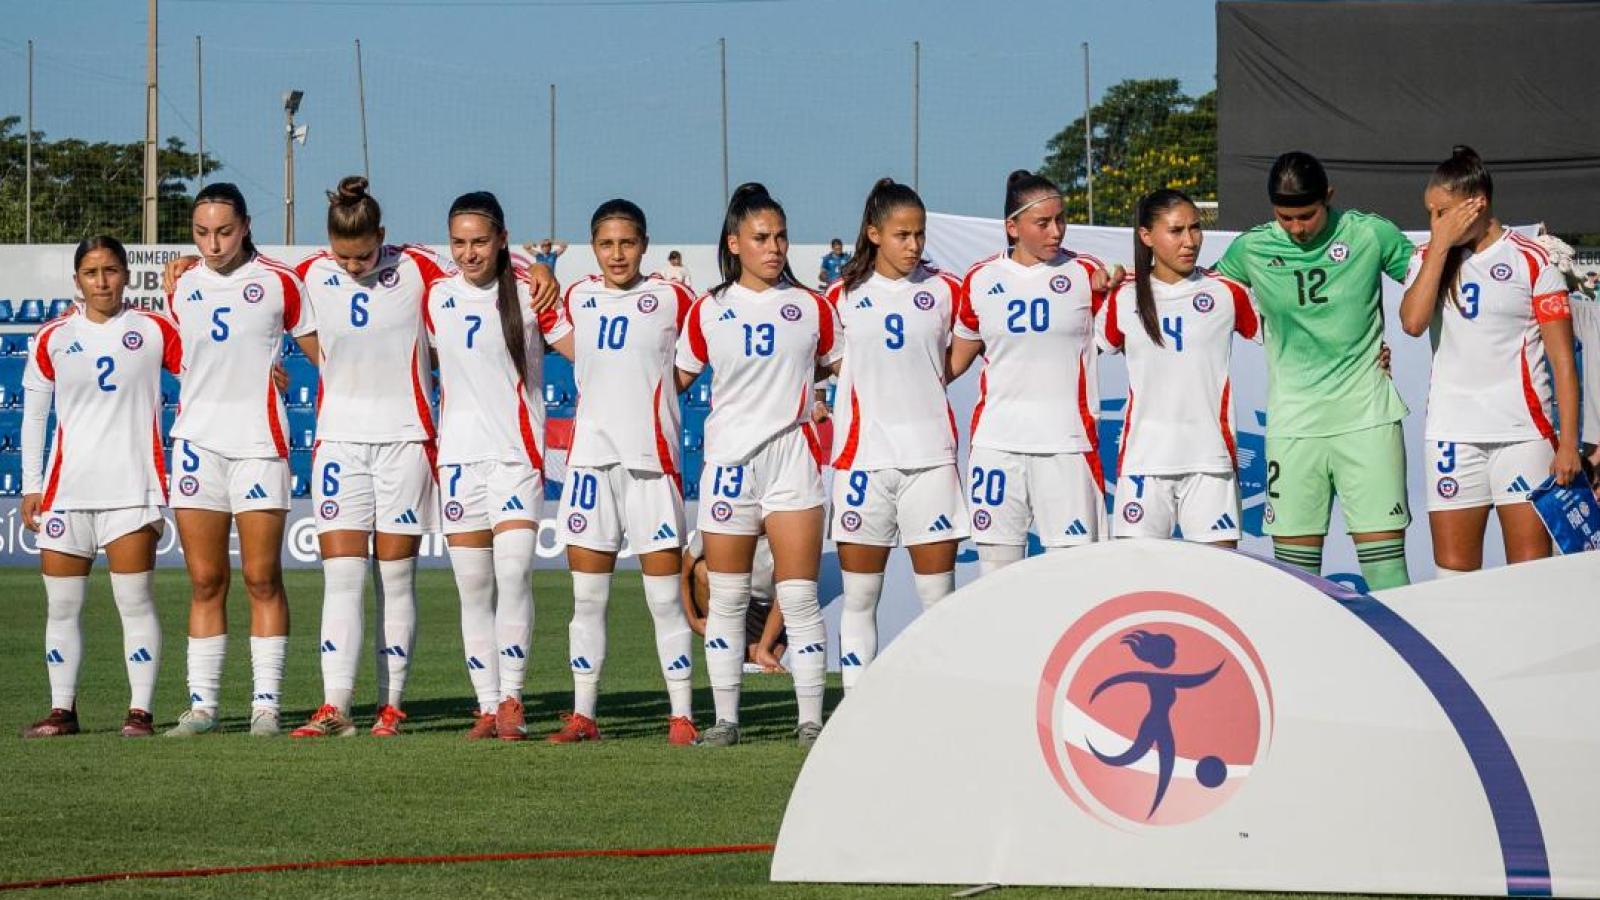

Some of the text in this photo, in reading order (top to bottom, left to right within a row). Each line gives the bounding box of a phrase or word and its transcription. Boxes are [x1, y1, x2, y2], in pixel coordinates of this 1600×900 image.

[128, 250, 180, 265] ONMEBO
[1294, 268, 1329, 306] 12
[1461, 282, 1481, 320] 3
[211, 306, 231, 342] 5
[350, 292, 370, 328] 6
[1007, 298, 1051, 334] 20
[464, 315, 482, 349] 7
[597, 315, 630, 350] 10
[742, 323, 776, 357] 13
[884, 313, 905, 350] 9
[1162, 316, 1183, 352] 4
[96, 355, 117, 392] 2
[182, 440, 200, 473] 5
[1436, 441, 1457, 475] 3
[322, 461, 341, 497] 6
[447, 464, 462, 497] 7
[570, 471, 597, 511] 10
[713, 465, 744, 499] 13
[846, 470, 869, 507] 9
[971, 466, 1007, 506] 20
[1266, 460, 1280, 499] 2
